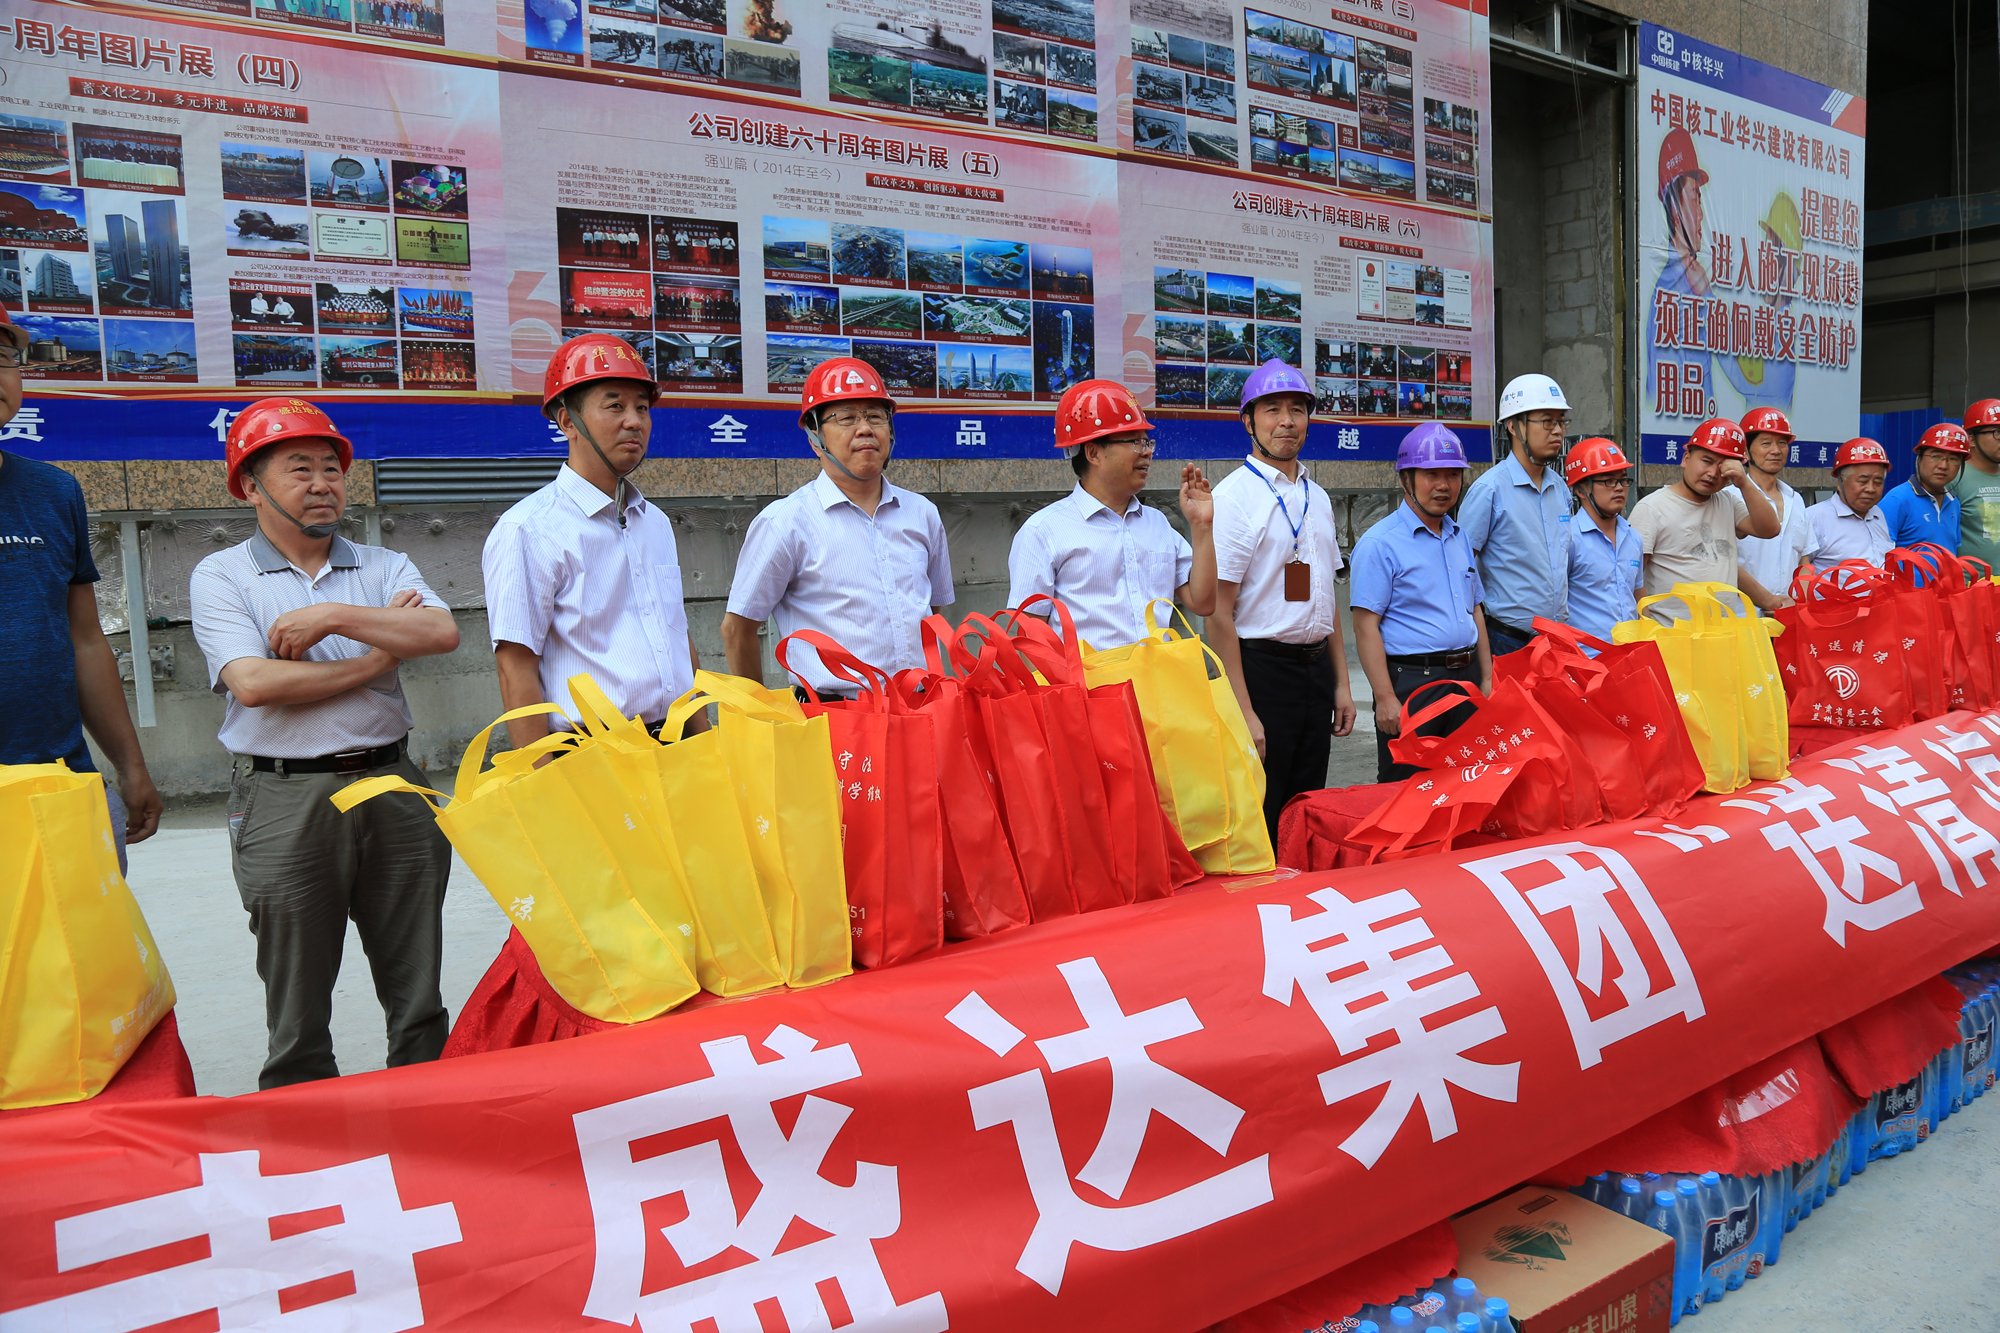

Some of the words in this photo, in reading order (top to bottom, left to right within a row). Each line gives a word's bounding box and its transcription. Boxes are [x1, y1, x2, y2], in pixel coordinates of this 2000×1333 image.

[0, 17, 301, 92] 周年图片展（四）
[1651, 53, 1680, 72] 中国核建
[1681, 48, 1724, 79] 中核华兴
[1651, 88, 1850, 179] 中国核工业华兴建设有限公司
[872, 176, 998, 201] 借改革之势、创新驱动、做大做强
[1801, 187, 1859, 249] 提醒您
[1655, 289, 1857, 366] 须正确佩戴安全防护
[709, 414, 748, 443] 全
[956, 420, 986, 446] 品
[1337, 428, 1360, 450] 越
[1666, 440, 1678, 461] 责
[1789, 445, 1800, 463] 质
[1818, 445, 1828, 465] 卓
